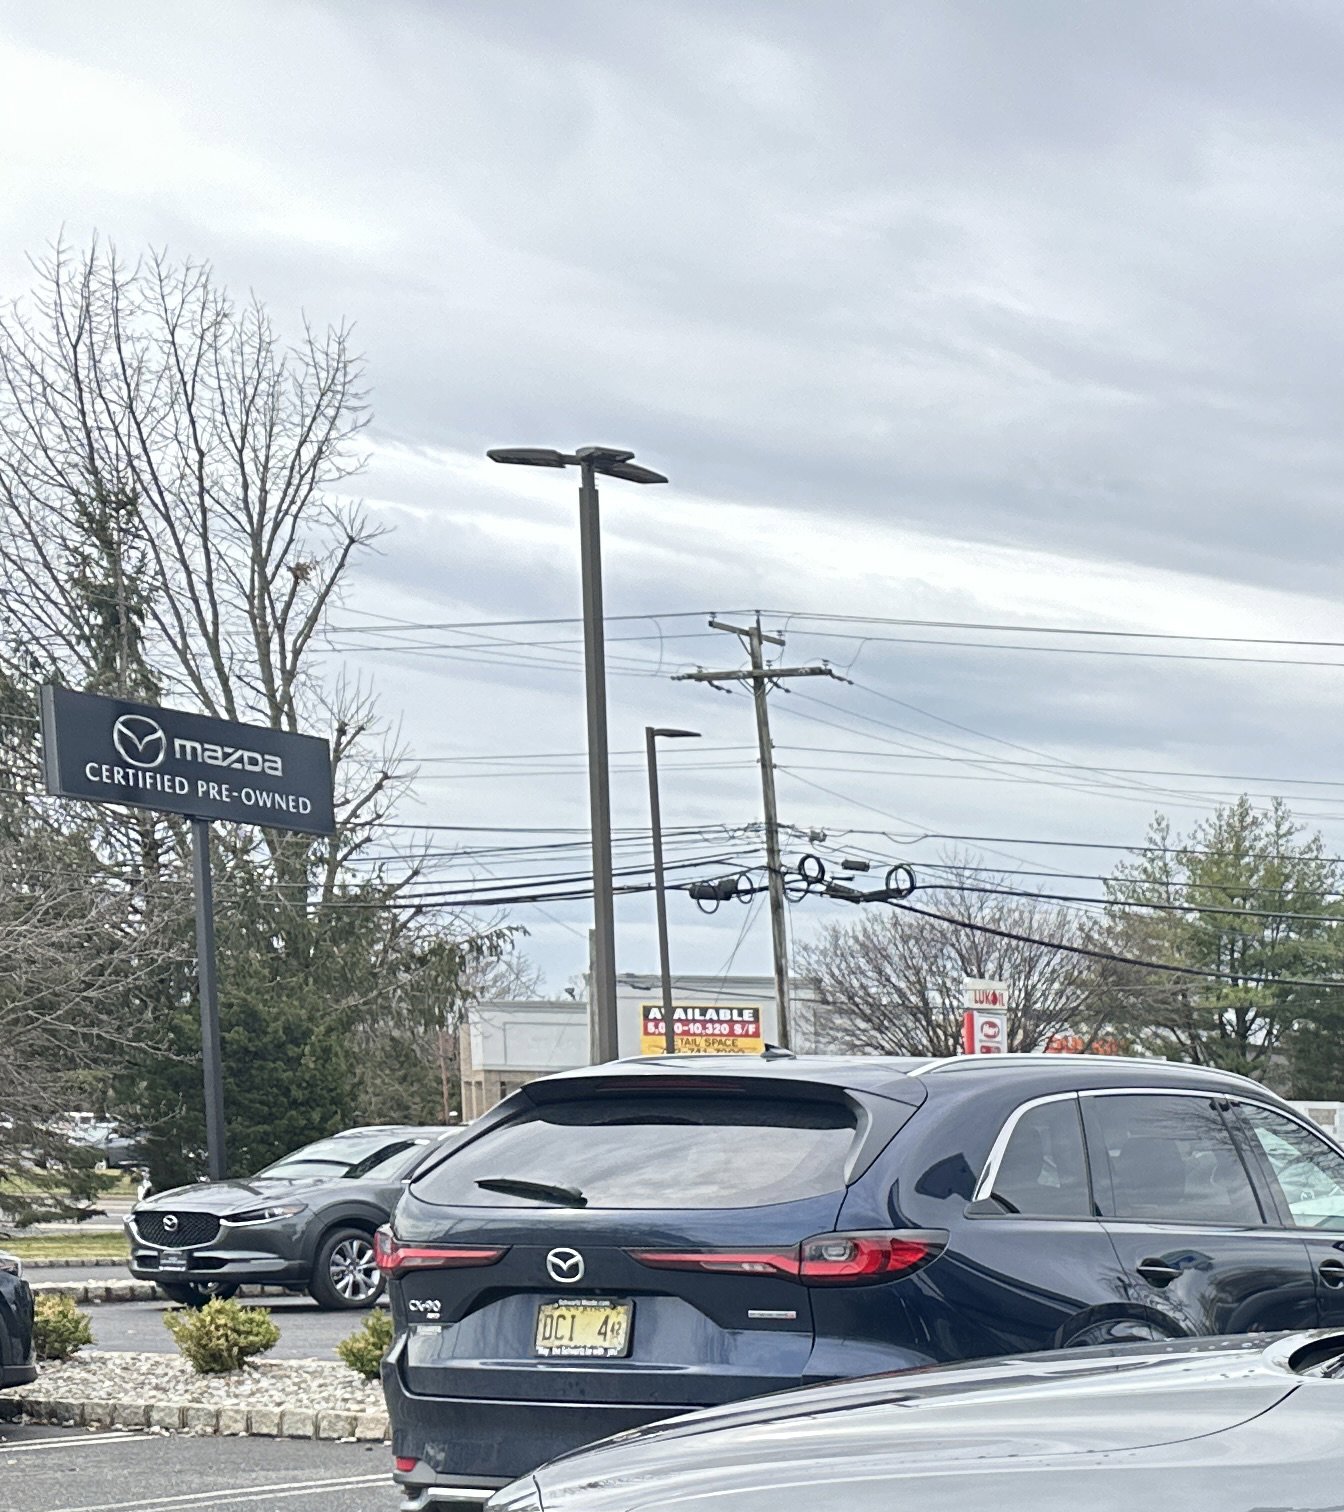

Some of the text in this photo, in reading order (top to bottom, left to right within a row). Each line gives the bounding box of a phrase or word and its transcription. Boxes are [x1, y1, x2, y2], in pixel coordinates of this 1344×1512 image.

[85, 762, 312, 814] CERTIFIED PRE-OWNED
[973, 990, 1006, 1006] LUKOIL
[648, 1007, 755, 1021] AAILABLE
[647, 1022, 756, 1035] 5,00-10,320 S/F
[704, 1038, 739, 1048] SPACE
[408, 1299, 441, 1312] CX-90
[541, 1314, 577, 1342] DCI
